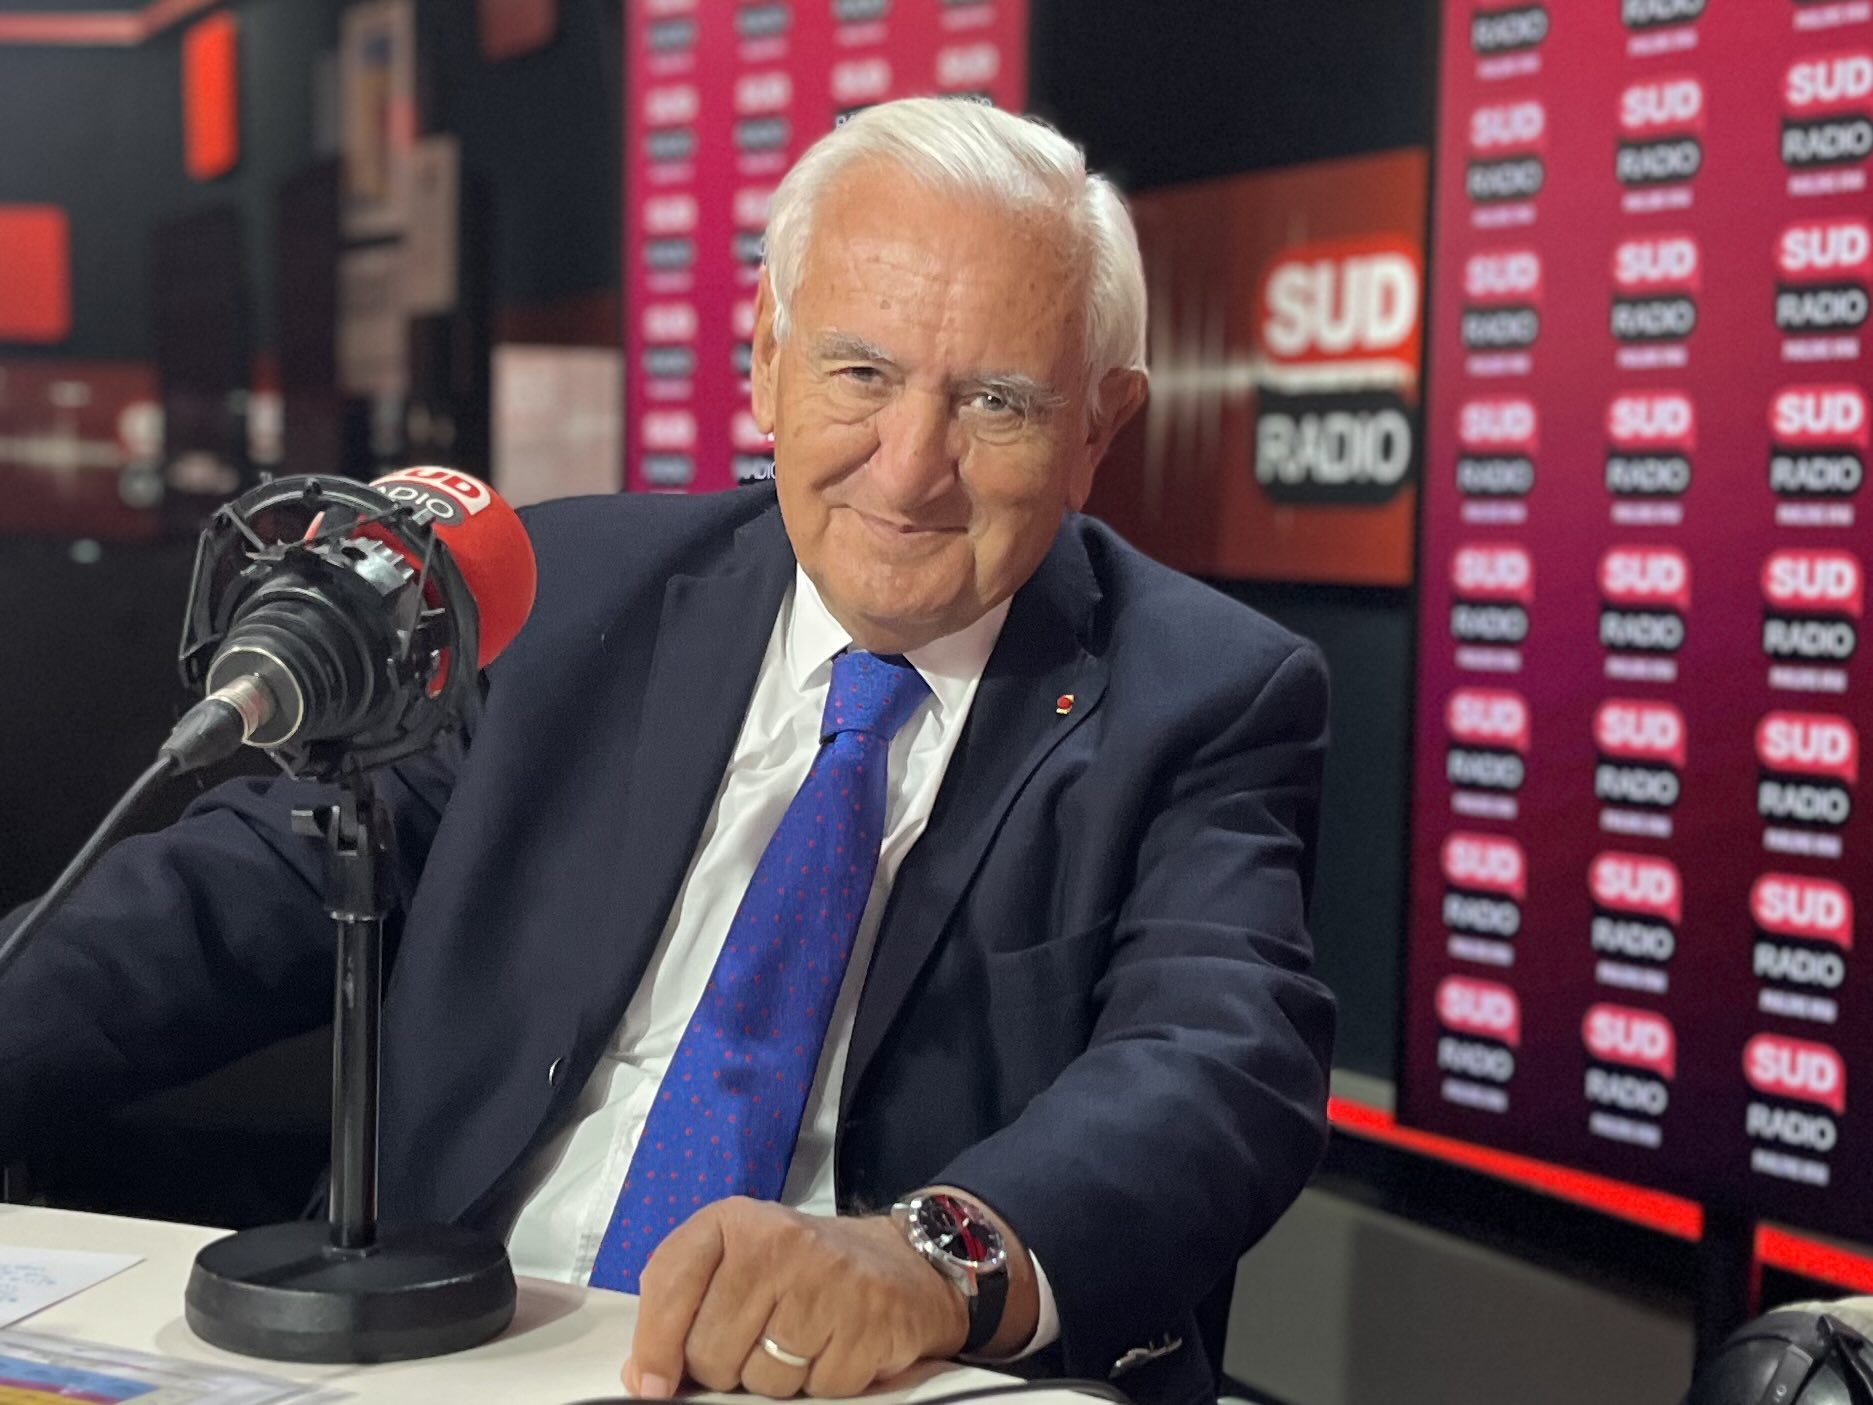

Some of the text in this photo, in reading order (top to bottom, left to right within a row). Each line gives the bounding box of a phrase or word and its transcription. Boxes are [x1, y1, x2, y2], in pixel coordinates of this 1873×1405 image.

[1472, 10, 1547, 47] RADIO
[1786, 55, 1873, 106] SUD
[1470, 101, 1545, 148] SUD
[1621, 80, 1702, 128] SUD
[1617, 142, 1700, 179] RADIO
[1783, 122, 1873, 160] RADIO
[1467, 161, 1542, 196] RADIO
[1615, 238, 1697, 284] SUD
[1780, 224, 1870, 271] SUD
[1465, 251, 1540, 296] SUD
[1264, 253, 1418, 356] SUD
[1612, 301, 1694, 334] RADIO
[1777, 290, 1867, 324] RADIO
[1462, 311, 1537, 344] RADIO
[1461, 400, 1536, 443] SUD
[1610, 396, 1692, 439] SUD
[1775, 391, 1864, 435] SUD
[1256, 411, 1411, 484] RADIO
[1458, 461, 1532, 491] RADIO
[1607, 459, 1689, 490] RADIO
[1771, 458, 1861, 489] RADIO
[1456, 549, 1529, 589] SUD
[1604, 552, 1685, 594] SUD
[1768, 556, 1857, 599] SUD
[1453, 607, 1526, 638] RADIO
[1601, 614, 1682, 647] RADIO
[1765, 621, 1854, 656] RADIO
[1452, 694, 1525, 737] SUD
[1600, 706, 1680, 750] SUD
[1763, 719, 1851, 765] SUD
[1449, 752, 1522, 786] RADIO
[1597, 767, 1677, 803] RADIO
[1760, 783, 1848, 821] RADIO
[1448, 839, 1521, 884] SUD
[1596, 859, 1676, 906] SUD
[1445, 897, 1518, 933] RADIO
[1758, 881, 1846, 930] SUD
[1593, 919, 1673, 958] RADIO
[1755, 945, 1843, 986] RADIO
[1442, 983, 1514, 1030] SUD
[1590, 1011, 1669, 1060] SUD
[1440, 1040, 1512, 1079] RADIO
[1751, 1042, 1838, 1093] SUD
[1587, 1071, 1666, 1112] RADIO
[1748, 1105, 1835, 1149] RADIO
